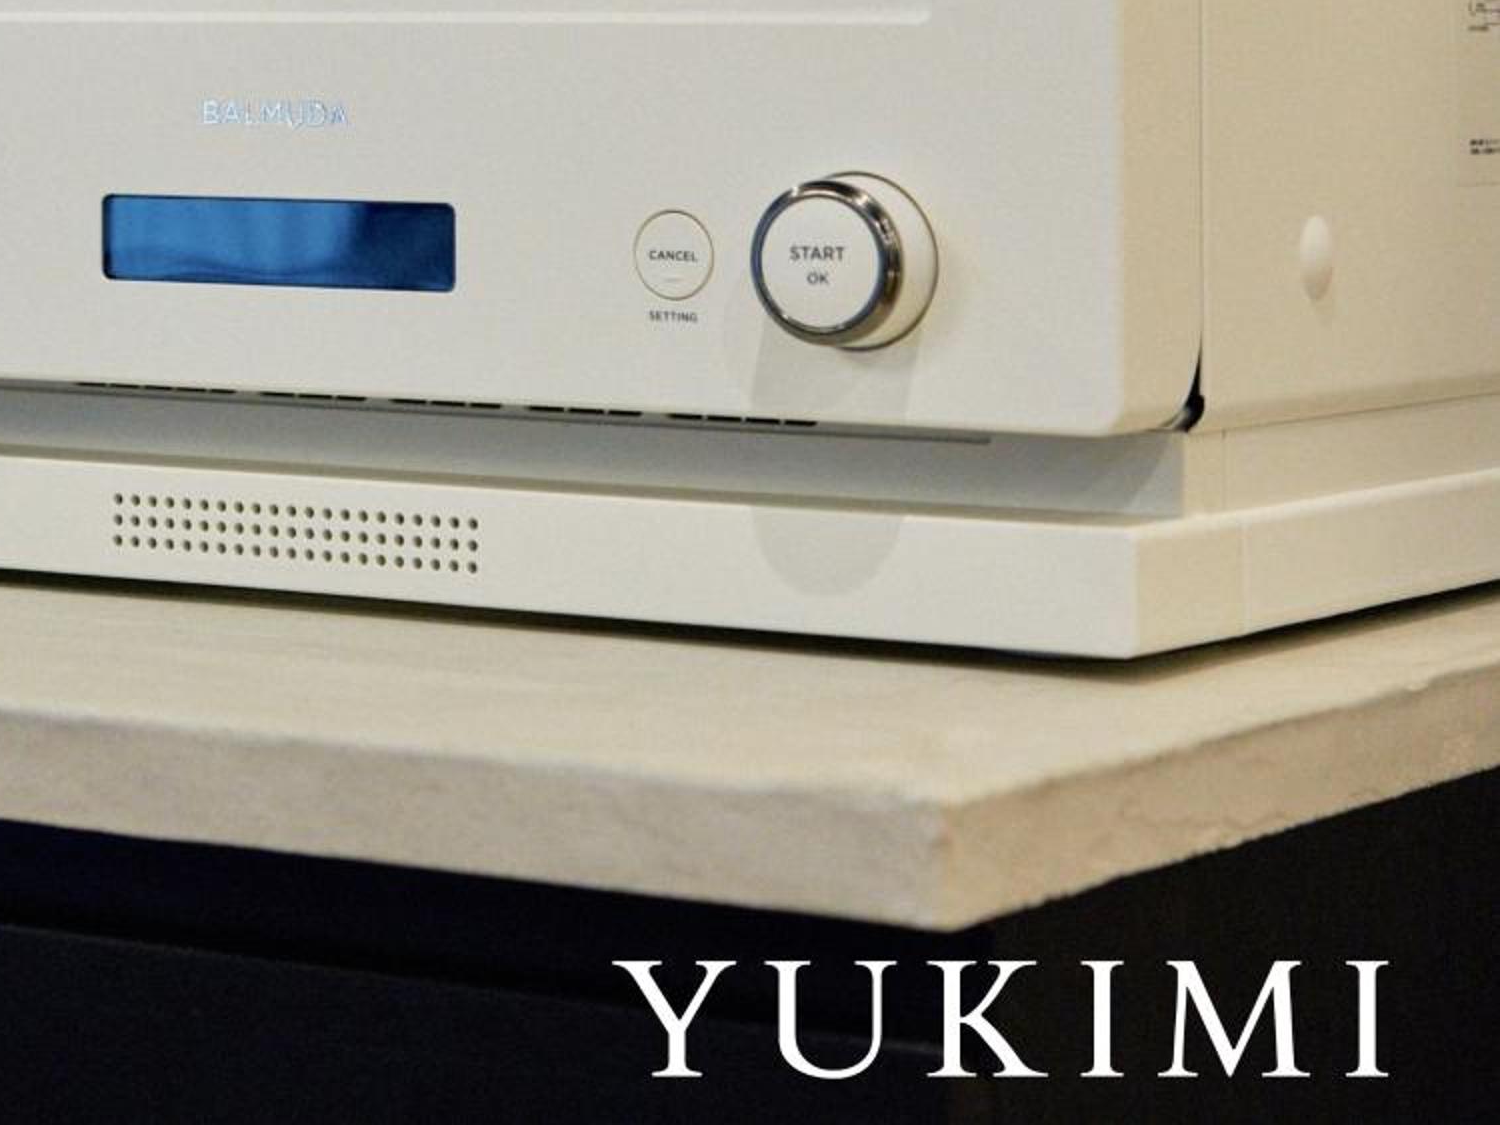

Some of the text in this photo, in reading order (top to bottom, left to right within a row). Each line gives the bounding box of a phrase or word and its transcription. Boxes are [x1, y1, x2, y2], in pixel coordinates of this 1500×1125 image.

[202, 98, 349, 126] BALMUDA
[648, 250, 698, 263] CANCEL
[789, 245, 845, 262] START
[806, 272, 829, 286] OK
[648, 310, 698, 324] SETTING
